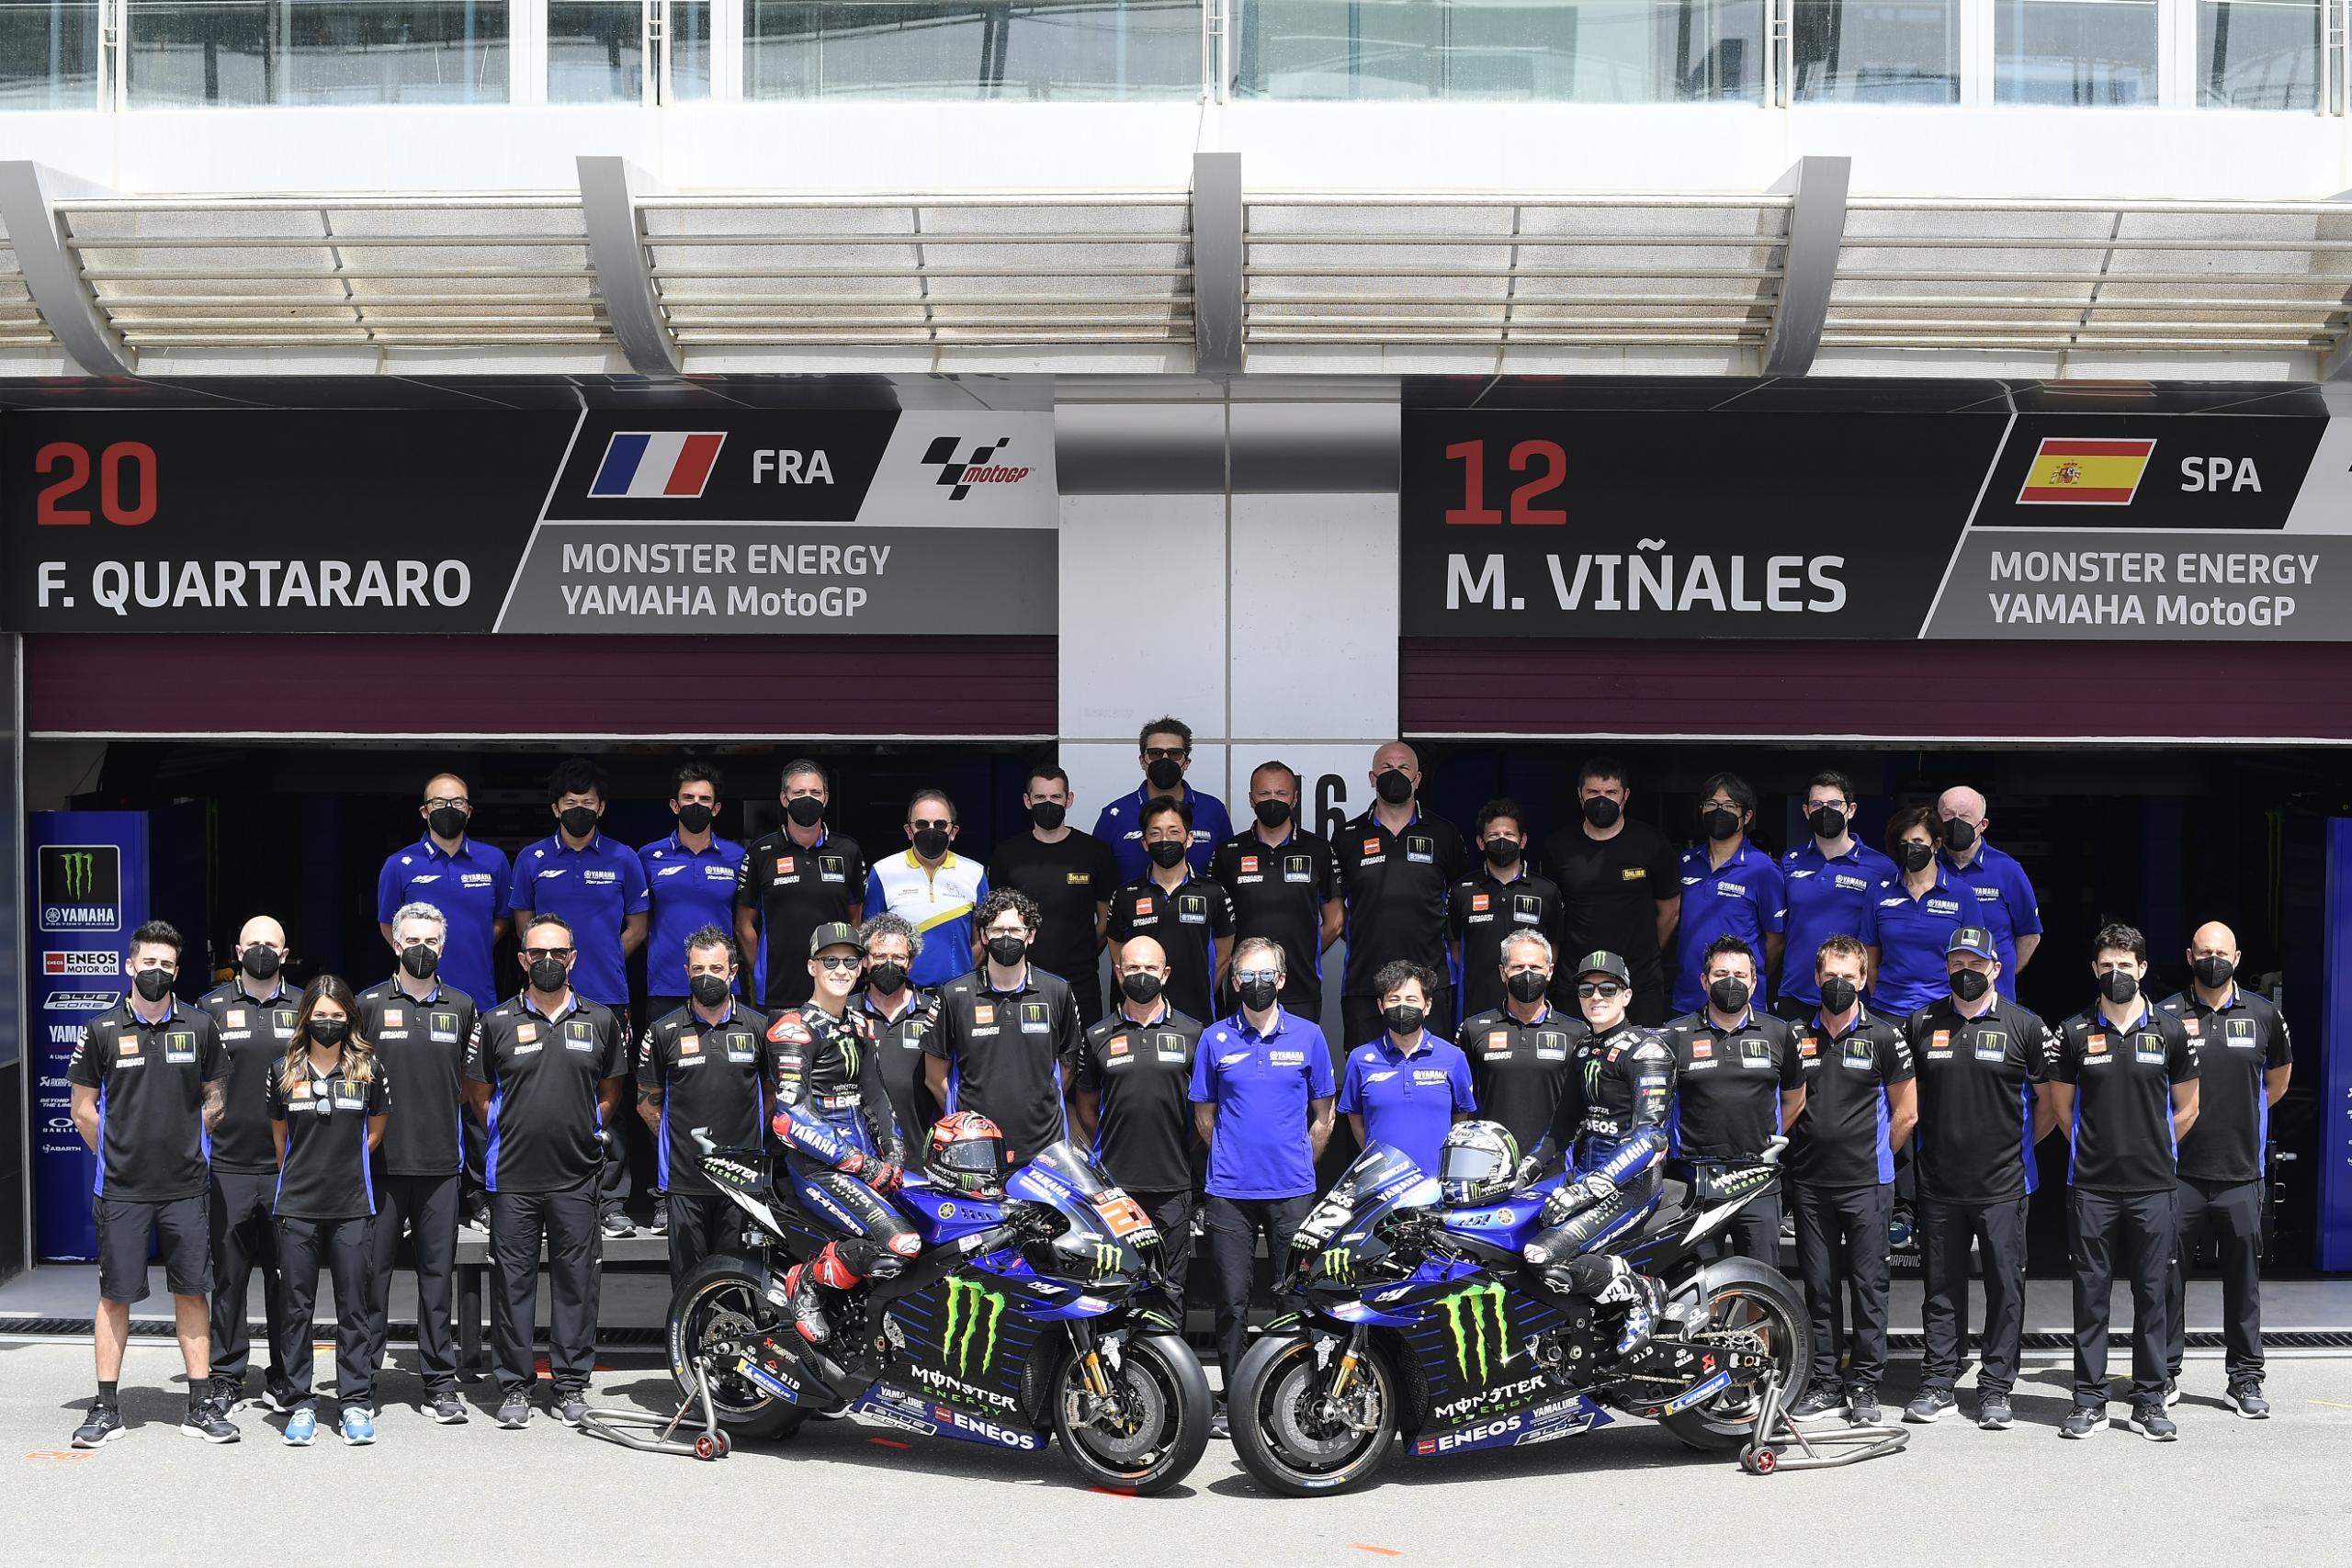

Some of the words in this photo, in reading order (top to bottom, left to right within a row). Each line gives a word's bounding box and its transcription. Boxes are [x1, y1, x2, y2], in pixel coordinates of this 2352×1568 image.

[35, 441, 157, 525] 20
[752, 449, 834, 485] FRA
[1445, 439, 1567, 525] 12
[2180, 456, 2262, 492] SPA
[561, 543, 737, 574] MONSTER
[748, 544, 891, 575] ENERGY
[1446, 553, 1525, 610] M.
[1546, 538, 1847, 613] VIÑALES
[1989, 551, 2166, 583] MONSTER
[2177, 553, 2319, 584] ENERGY
[38, 561, 74, 608] F.
[93, 559, 471, 615] QUARTARARO
[560, 585, 717, 615] YAMAHA
[727, 586, 867, 616] MotoGP
[1988, 592, 2146, 625] YAMAHA
[2155, 594, 2296, 626] MotoGP
[61, 908, 115, 922] YAMAHA
[66, 953, 117, 964] ENEOS
[790, 1120, 837, 1157] YAMAHA
[704, 1163, 746, 1186] ENERGY
[1603, 1138, 1653, 1177] YAMAHA
[831, 1173, 873, 1208] MONSTER
[831, 1184, 860, 1206] ENERGY
[1028, 1168, 1072, 1201] YAMAHA
[1724, 1172, 1770, 1194] ENERGY
[1580, 1189, 1624, 1224] MONSTER
[911, 1364, 1017, 1412] MONSTER
[1434, 1374, 1547, 1418] MONSTER
[1532, 1394, 1581, 1418] YAMALUBE
[954, 1412, 1035, 1450] ENEOS
[1439, 1415, 1521, 1450] ENEOS
